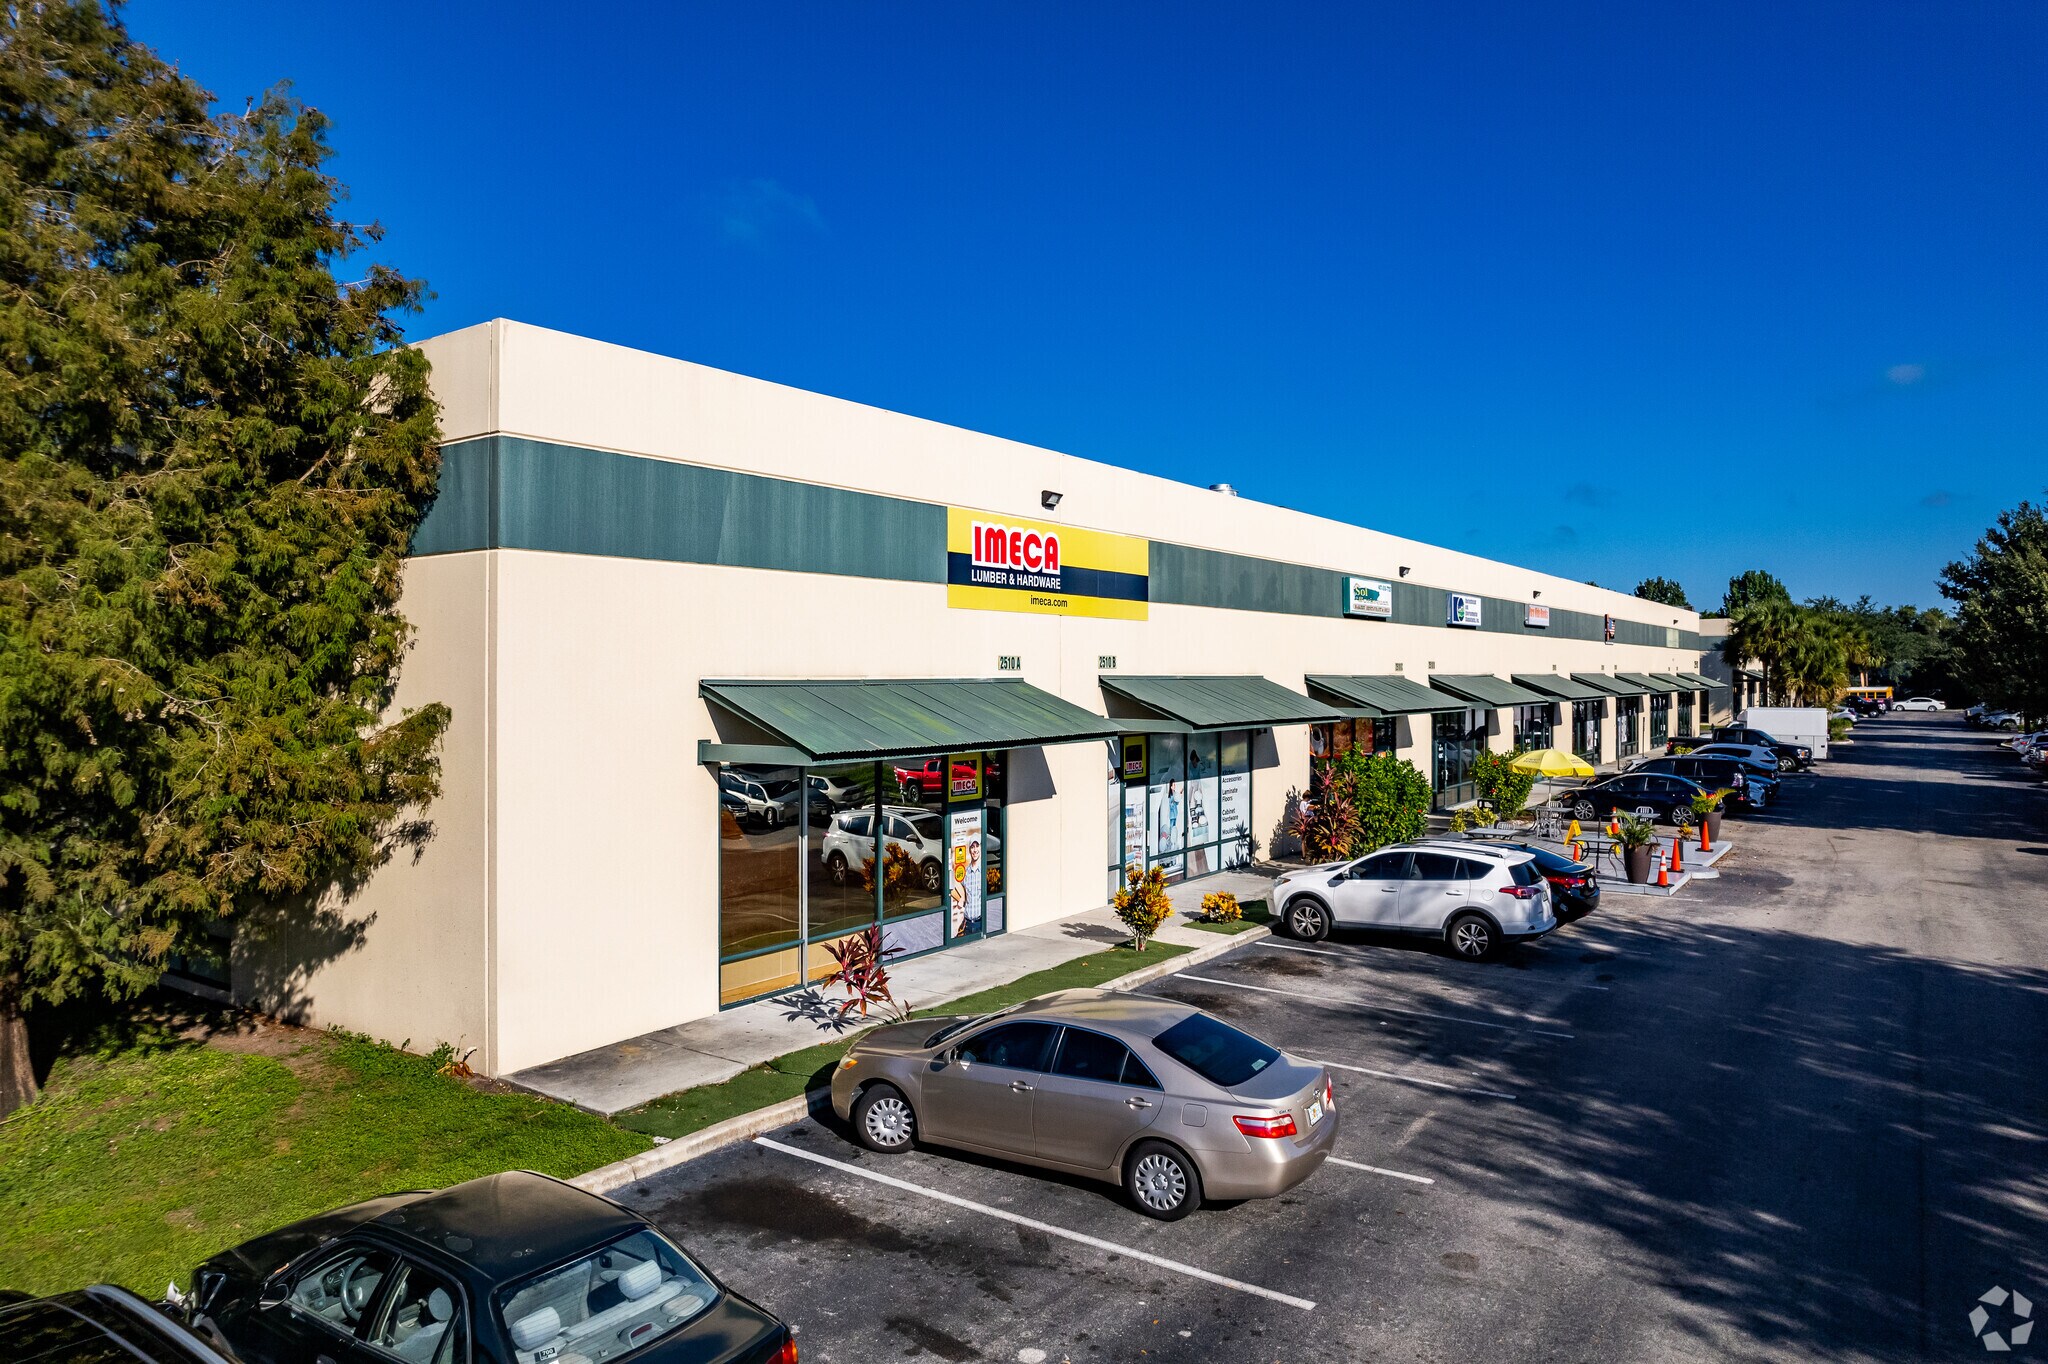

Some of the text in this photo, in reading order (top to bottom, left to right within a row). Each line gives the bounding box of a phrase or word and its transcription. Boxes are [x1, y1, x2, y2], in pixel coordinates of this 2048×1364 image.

[973, 524, 1059, 571] IMECA
[971, 569, 1061, 590] LUMBER & HARDWARE
[1355, 586, 1368, 597] Sol
[1030, 594, 1068, 608] imeca.com
[1000, 656, 1015, 669] 2510
[1099, 656, 1111, 669] 2510
[1126, 761, 1142, 771] IMECA
[953, 779, 976, 791] IMECA
[954, 816, 978, 825] Welcome
